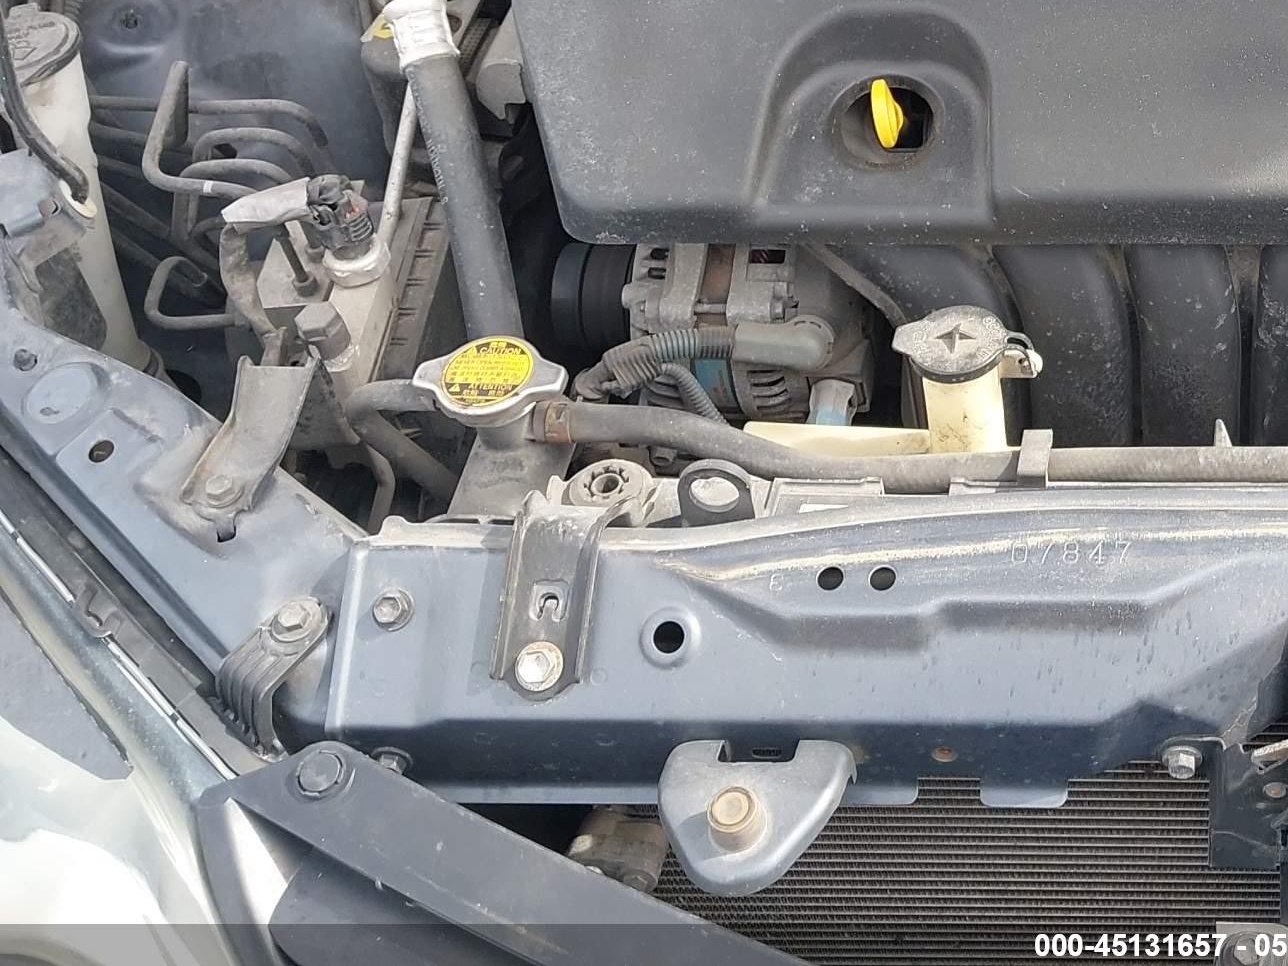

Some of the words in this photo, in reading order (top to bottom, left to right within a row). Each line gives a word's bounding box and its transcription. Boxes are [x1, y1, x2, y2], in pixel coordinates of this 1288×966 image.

[479, 346, 522, 355] CAUTION
[468, 383, 513, 391] ATTENTION
[1011, 540, 1132, 565] 07847
